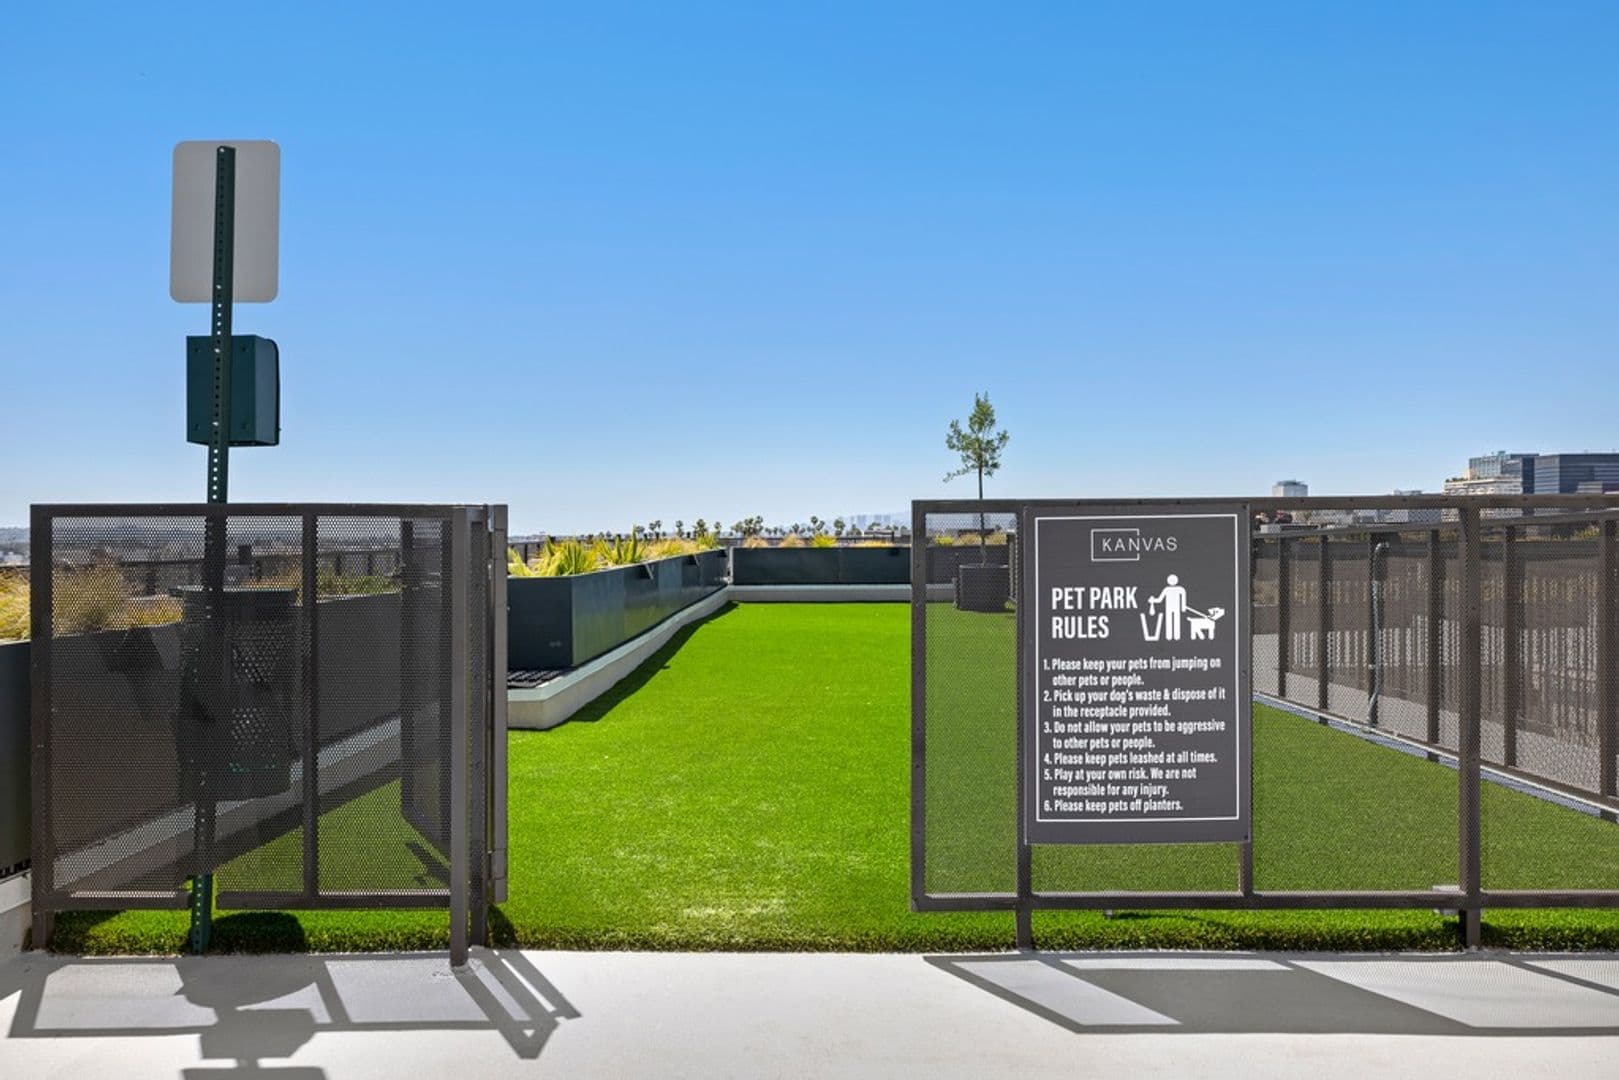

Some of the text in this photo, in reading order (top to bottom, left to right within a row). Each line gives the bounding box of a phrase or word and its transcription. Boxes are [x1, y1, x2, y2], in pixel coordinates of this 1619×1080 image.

[1102, 537, 1178, 552] KANVAS
[1052, 586, 1138, 610] PET PARK
[1052, 616, 1109, 639] RULES
[1044, 657, 1221, 672] 1. Please keep your pets from jumping on
[1053, 673, 1145, 688] other pets or people.
[1044, 688, 1226, 703] 2. Pick up your dog's waste & dispose of it
[1053, 705, 1171, 718] in the receptacle provided.
[1044, 719, 1225, 735] 3. Do not allow your pets to be aggressive
[1053, 737, 1155, 751] to other pets or people.
[1044, 751, 1218, 766] 4. Please keep pets leashed at all times.
[1044, 768, 1197, 783] 5. Play at your own risk. We are not
[1053, 783, 1169, 798] responsible for any injury.
[1044, 799, 1183, 813] 6. Please keep pets off planters.
